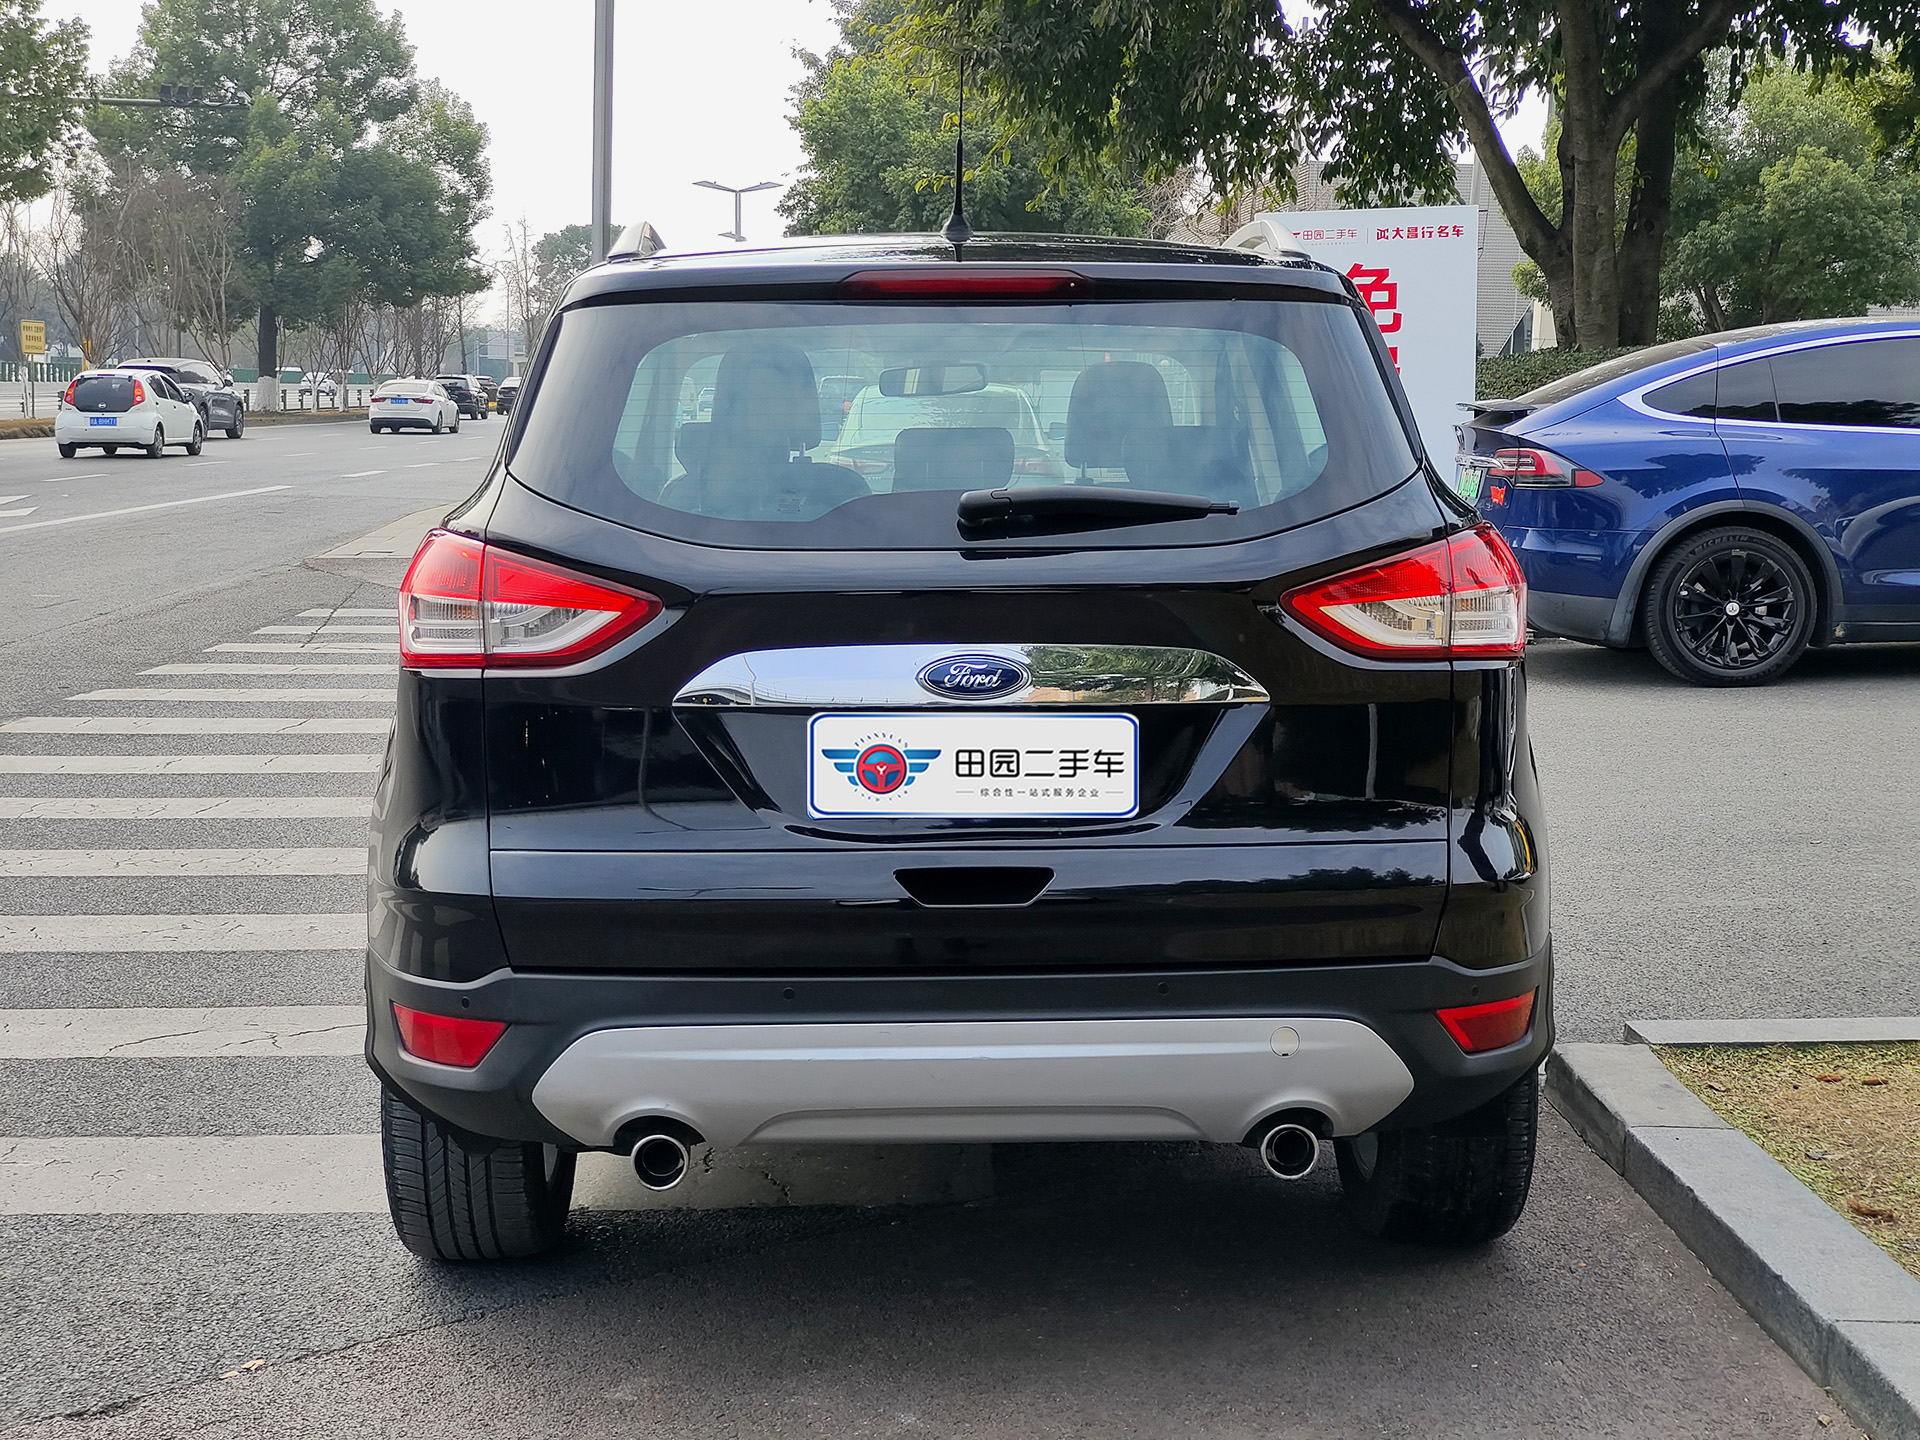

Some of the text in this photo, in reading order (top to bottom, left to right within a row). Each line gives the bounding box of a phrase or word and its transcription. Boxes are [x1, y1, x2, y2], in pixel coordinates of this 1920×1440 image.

[1302, 228, 1358, 240] 田园二手车
[1392, 225, 1464, 239] 大昌行名车
[1695, 535, 1749, 552] MICHELIN
[944, 663, 1003, 688] Ford
[877, 765, 887, 775] Y
[955, 748, 1125, 778] 田园二手车
[980, 787, 1100, 797] 综合性一站式服务企业
